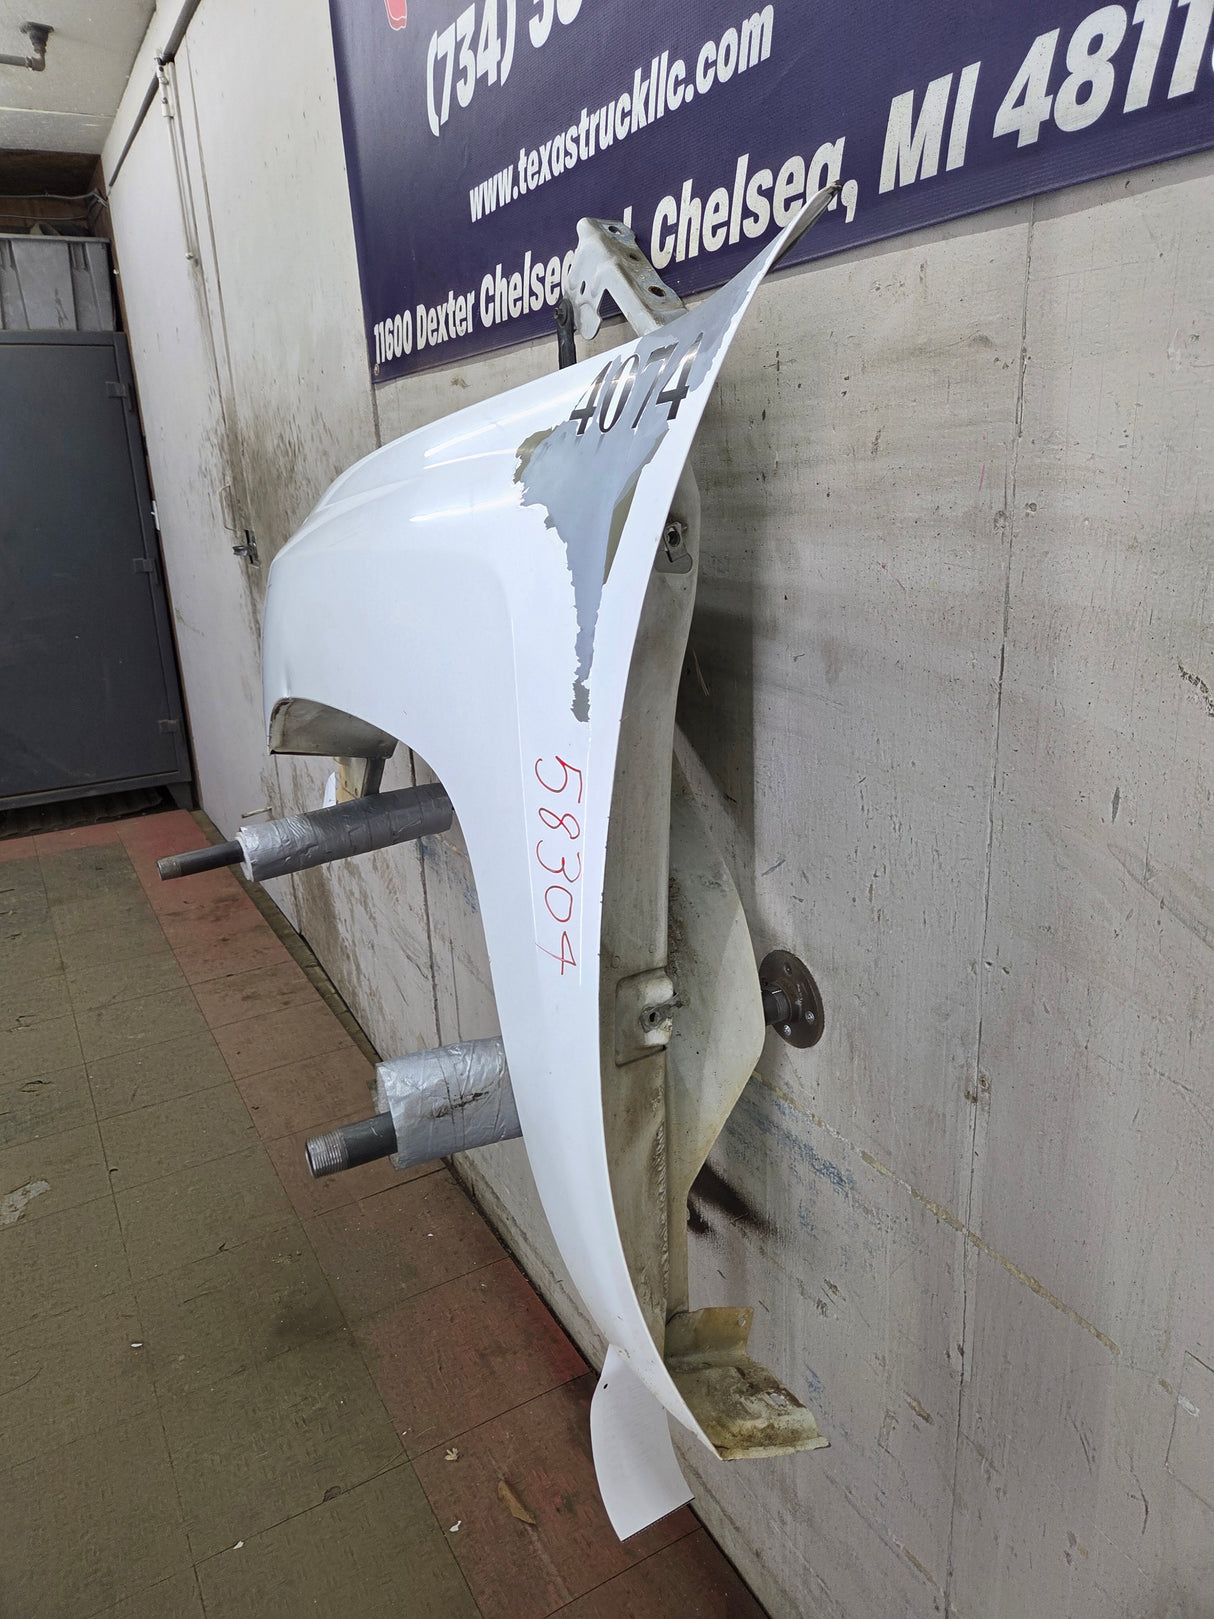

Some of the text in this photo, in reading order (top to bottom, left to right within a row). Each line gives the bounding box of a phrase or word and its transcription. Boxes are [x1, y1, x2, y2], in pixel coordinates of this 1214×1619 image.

[426, 0, 517, 137] (734)
[469, 4, 775, 223] www.texastruckllc.com
[373, 310, 413, 365] 11600
[416, 290, 475, 351] Dexter
[879, 61, 982, 195] MI
[993, 0, 1214, 148] 4811
[569, 332, 704, 435] 4074
[535, 756, 582, 975] 58304
